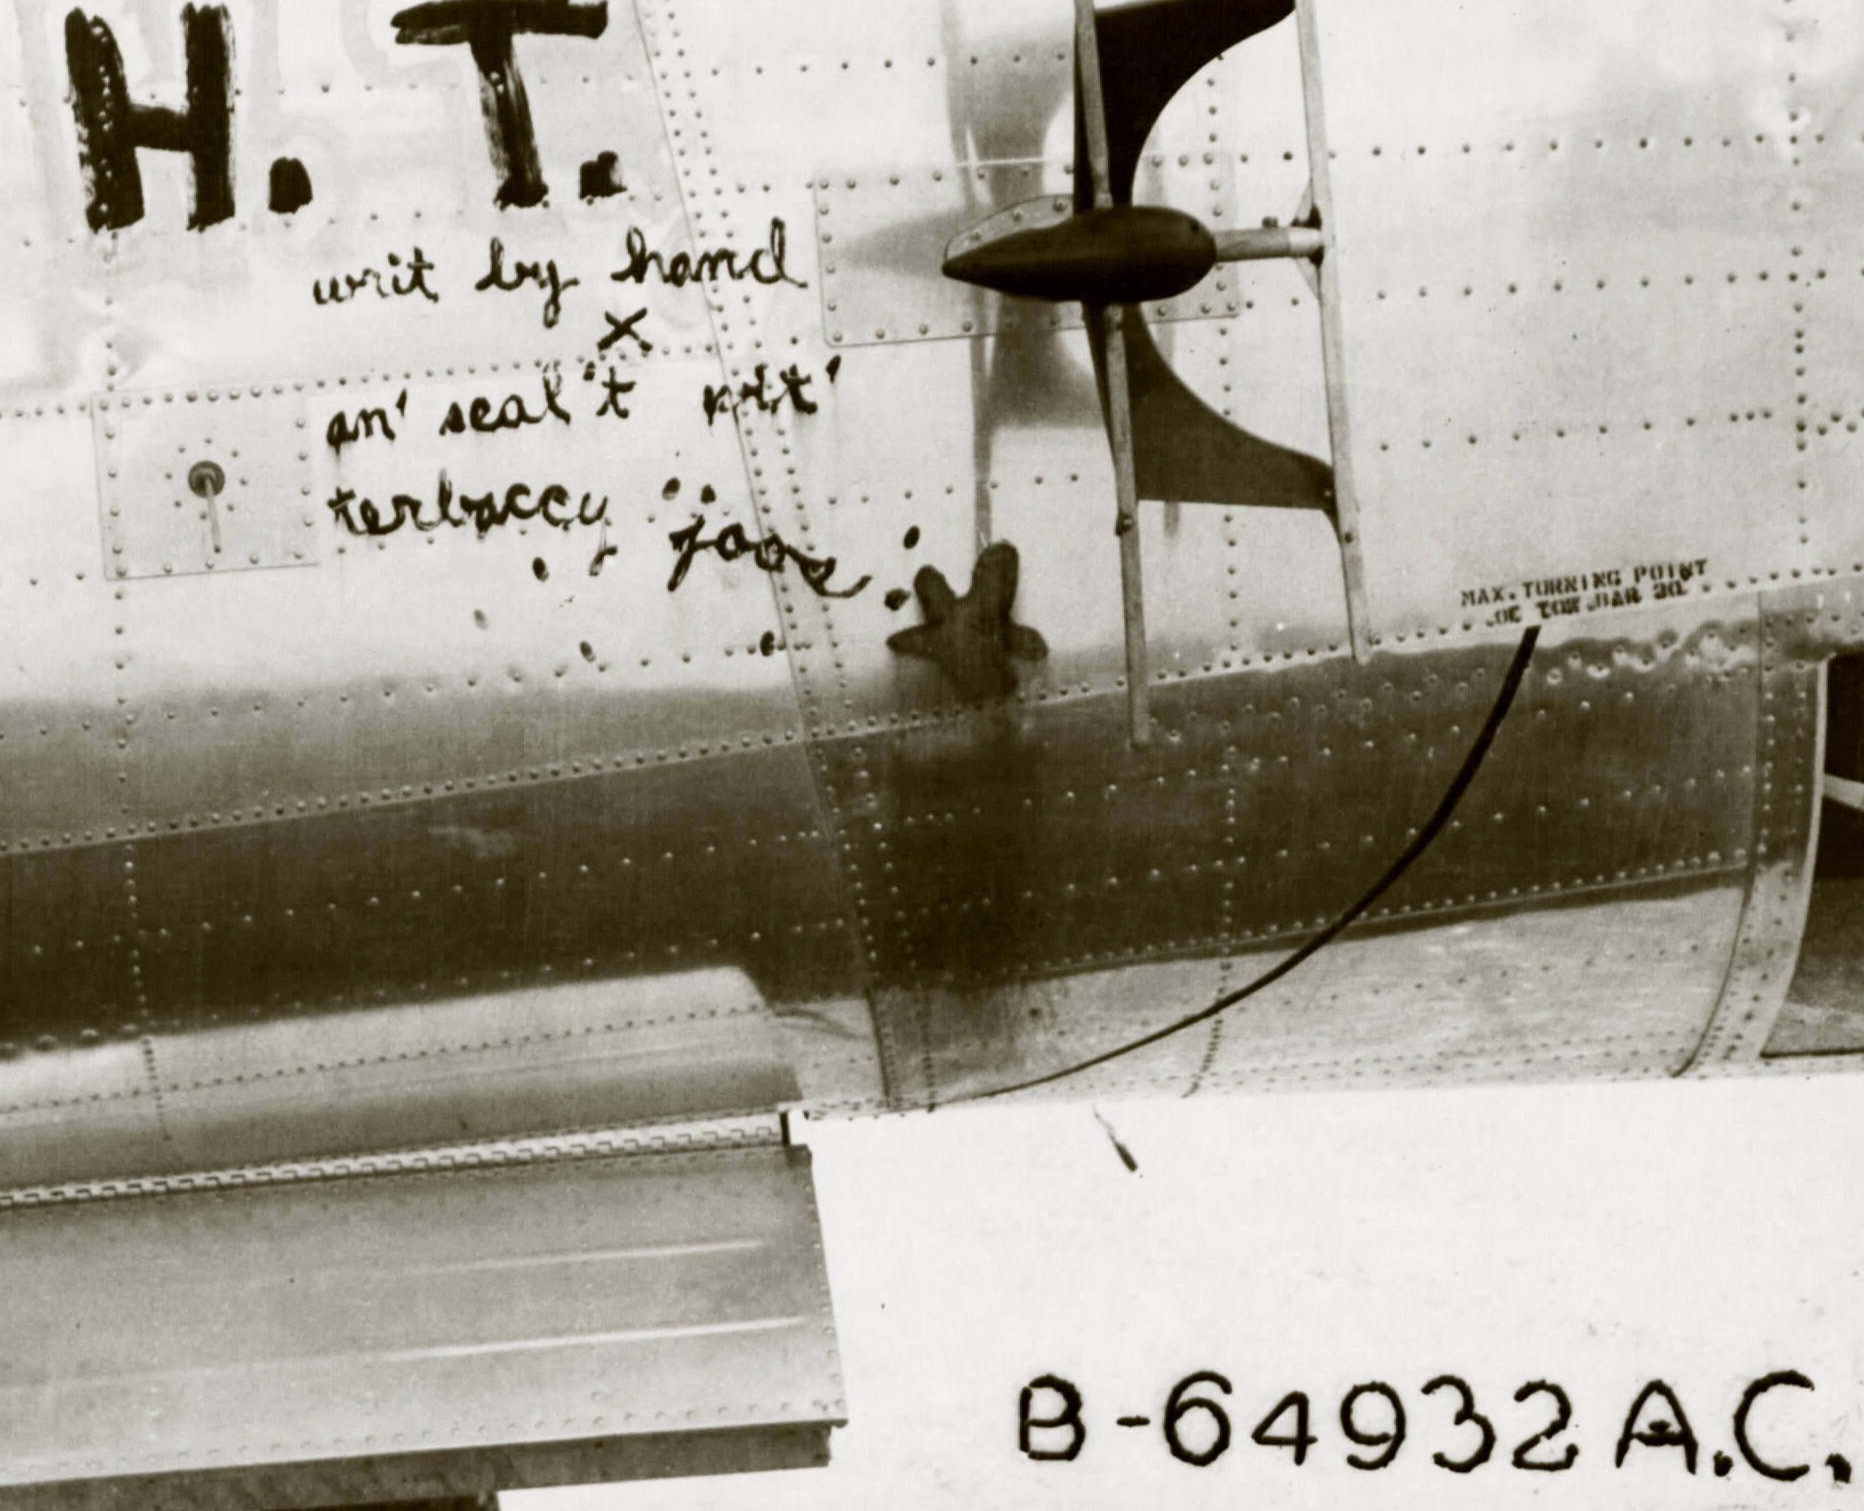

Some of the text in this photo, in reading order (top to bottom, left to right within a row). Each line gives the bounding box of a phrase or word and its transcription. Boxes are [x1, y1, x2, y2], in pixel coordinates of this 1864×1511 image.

[65, 3, 313, 234] H.
[313, 217, 809, 329] writ by hand
[1460, 557, 1708, 609] MAX. TURNING POINT
